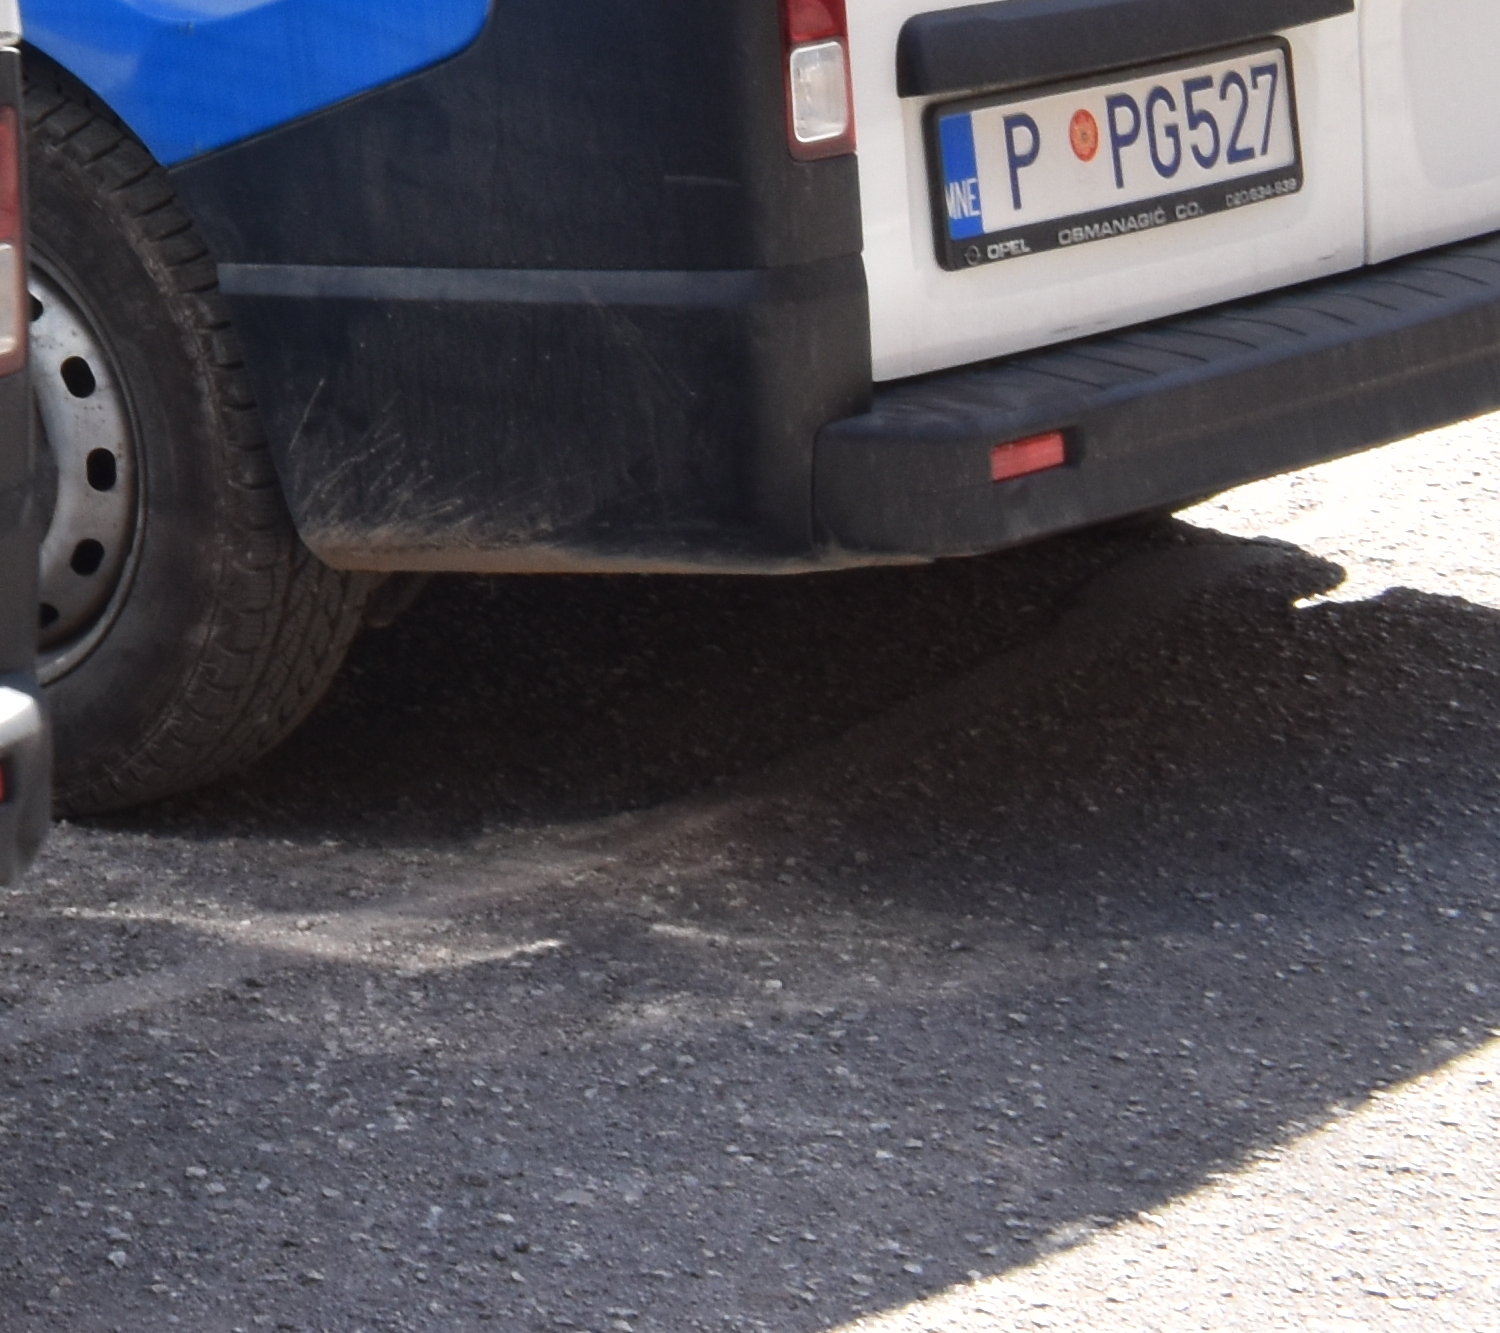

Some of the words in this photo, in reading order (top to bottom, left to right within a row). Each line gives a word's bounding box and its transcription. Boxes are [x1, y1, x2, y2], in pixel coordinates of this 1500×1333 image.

[1002, 112, 1042, 211] P
[1105, 63, 1280, 191] PG527
[986, 238, 1031, 261] OPEL
